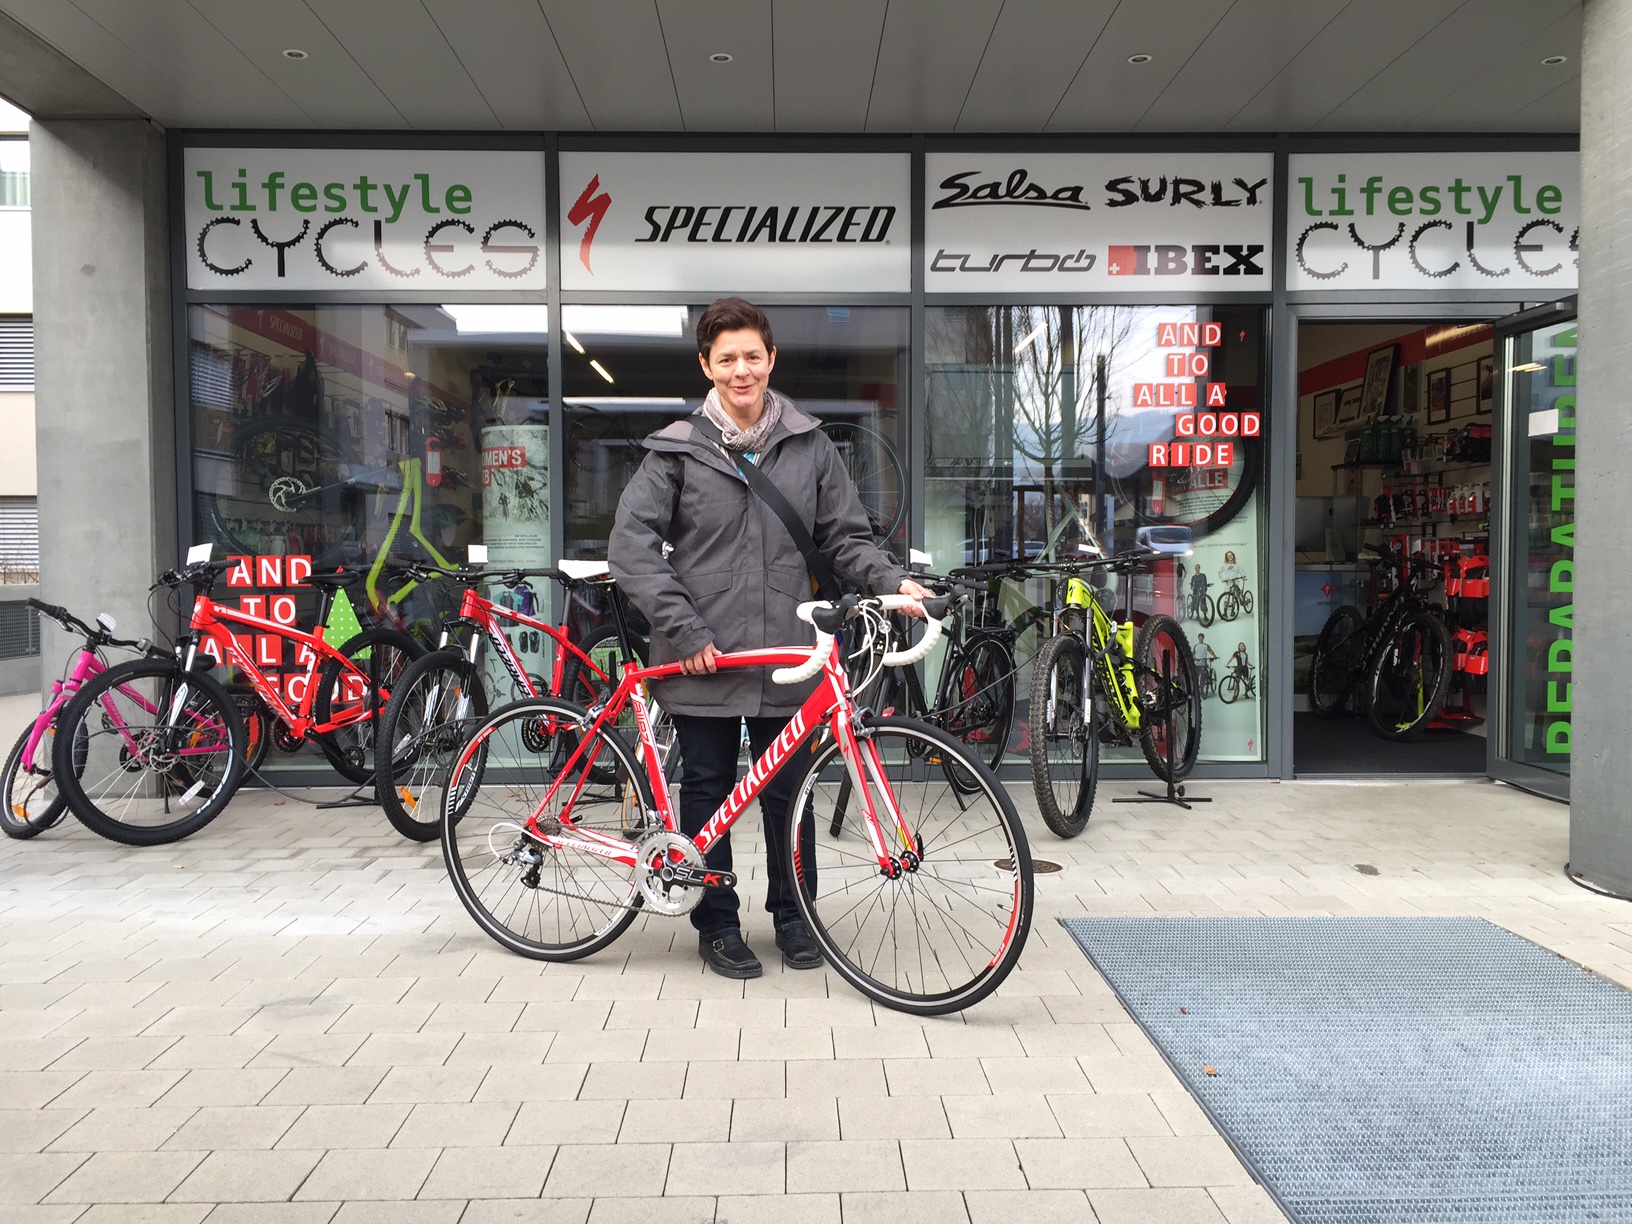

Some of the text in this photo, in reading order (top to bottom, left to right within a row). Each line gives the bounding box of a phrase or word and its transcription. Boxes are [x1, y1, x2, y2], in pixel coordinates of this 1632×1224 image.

[196, 168, 473, 224] lifestyle
[931, 168, 1268, 211] Salsa SURLY
[1297, 173, 1563, 225] lifestyle
[634, 205, 897, 243] SPECIALIZED
[196, 216, 541, 280] CYCLES
[929, 244, 1265, 276] turbo IBEX
[1295, 218, 1579, 281] CYCLE
[1160, 324, 1222, 346] AND
[1168, 354, 1209, 376] TO
[1136, 384, 1225, 406] ALL A
[1177, 414, 1260, 436] GOOD
[1151, 444, 1230, 465] RIDE
[230, 557, 312, 585] AND
[242, 597, 296, 625] TO
[699, 708, 806, 850] SPECIALIZED
